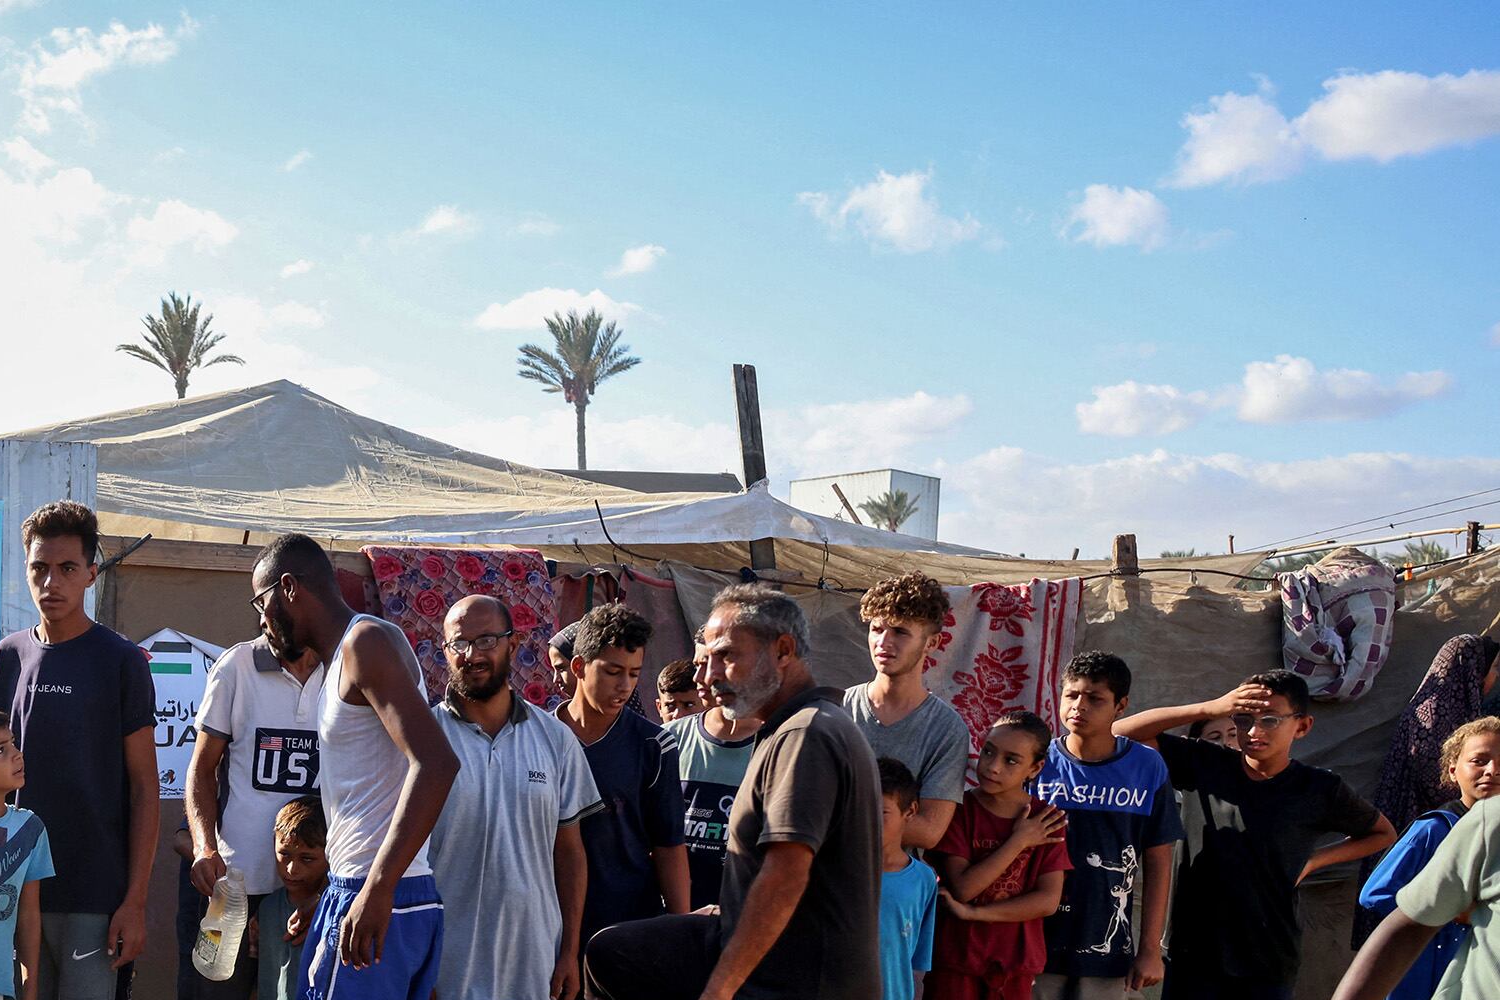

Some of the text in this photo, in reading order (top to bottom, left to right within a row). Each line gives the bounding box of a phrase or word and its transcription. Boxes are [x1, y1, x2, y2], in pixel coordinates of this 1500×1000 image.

[38, 684, 72, 694] JEANS
[155, 725, 197, 748] UA
[285, 737, 312, 750] TEAM
[528, 770, 546, 780] BOSS
[1037, 782, 1147, 807] FASHION
